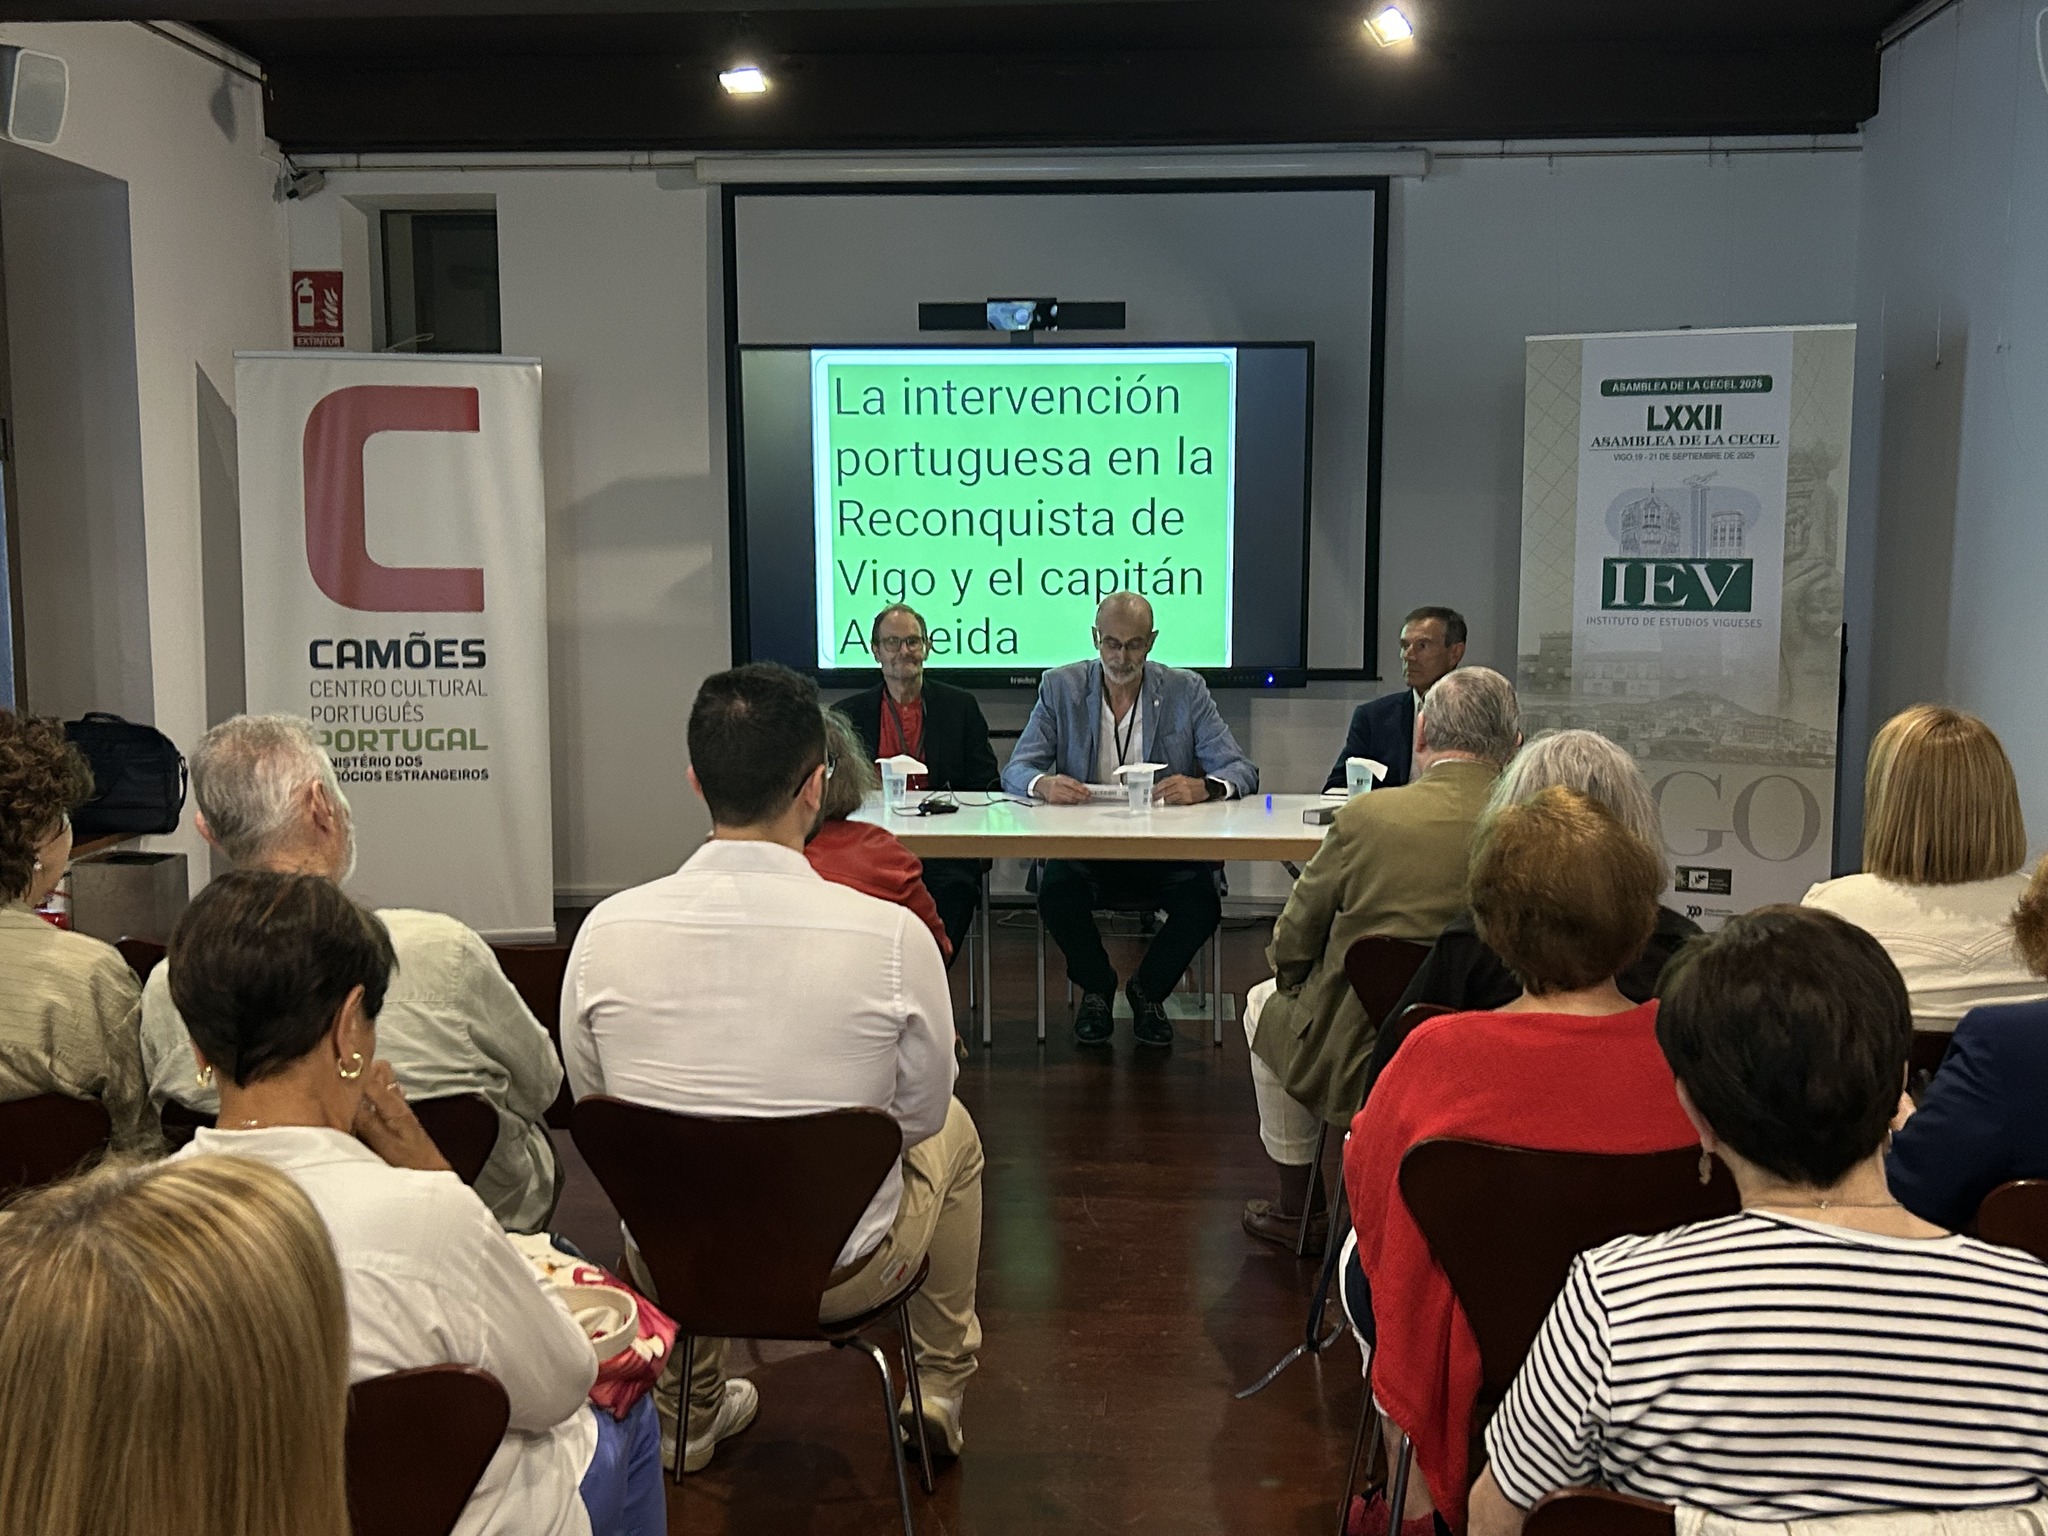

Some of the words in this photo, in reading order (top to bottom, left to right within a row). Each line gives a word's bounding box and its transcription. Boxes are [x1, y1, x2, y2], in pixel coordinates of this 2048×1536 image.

[297, 337, 340, 346] EXTINTOR
[835, 378, 885, 415] La
[904, 374, 1180, 416] intervención
[1612, 381, 1668, 392] ASAMBLEA
[1670, 380, 1684, 391] DE
[1686, 379, 1700, 390] LA
[1703, 379, 1737, 390] CECEL
[1647, 404, 1723, 431] LXXII
[1591, 436, 1676, 447] ASAMBLEA
[1680, 435, 1702, 446] DE
[1705, 434, 1725, 446] LA
[1728, 433, 1780, 445] CECEL
[837, 442, 1091, 486] portuguesa
[1108, 446, 1160, 475] en
[1178, 436, 1213, 475] la
[1660, 452, 1671, 460] DE
[1724, 451, 1735, 459] DE
[1737, 451, 1755, 459] 2025
[839, 498, 1114, 546] Reconquista
[1132, 497, 1184, 536] de
[837, 559, 936, 605] Vigo
[951, 567, 973, 606] y
[989, 558, 1023, 596] el
[1040, 556, 1203, 604] capitán
[1610, 562, 1744, 608] IEV
[1586, 616, 1639, 626] INSTITUTO
[1643, 617, 1656, 627] DE
[1659, 617, 1709, 627] ESTUDIOS
[1713, 618, 1762, 628] VIGUESES
[839, 617, 1018, 655] Aeida
[309, 631, 487, 670] CAMÕES
[310, 679, 386, 698] CENTRO
[391, 678, 488, 698] CULTURAL
[311, 700, 424, 724] PORTUGUÊS
[330, 754, 391, 768] NISTÉRIO
[395, 756, 423, 767] DOS
[386, 768, 489, 782] ESTRANGEIROS
[1651, 770, 1821, 862] GO
